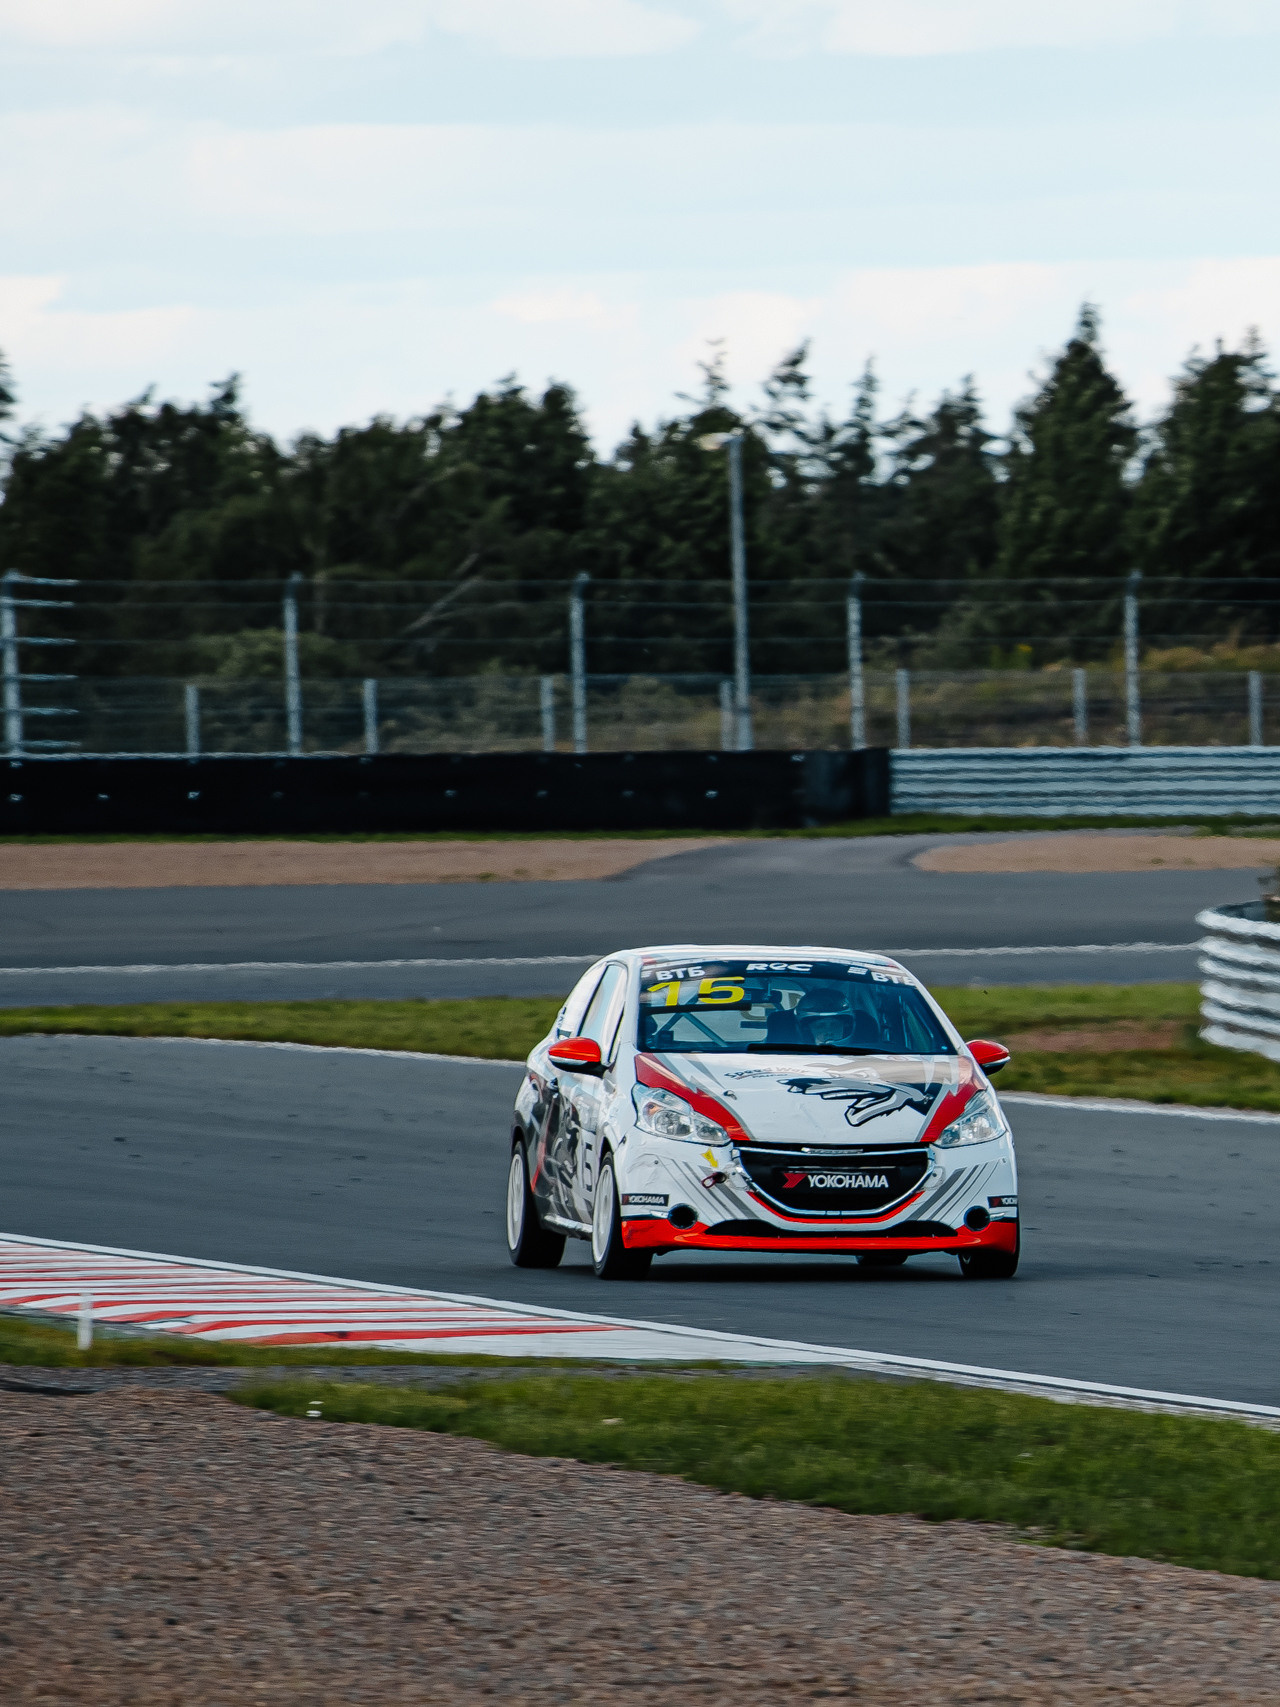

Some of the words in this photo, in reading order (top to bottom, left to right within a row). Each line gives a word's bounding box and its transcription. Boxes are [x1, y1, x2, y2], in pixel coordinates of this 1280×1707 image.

[656, 966, 705, 980] ВТБ
[647, 976, 745, 1006] 15
[807, 1175, 889, 1188] YOKOHAMA
